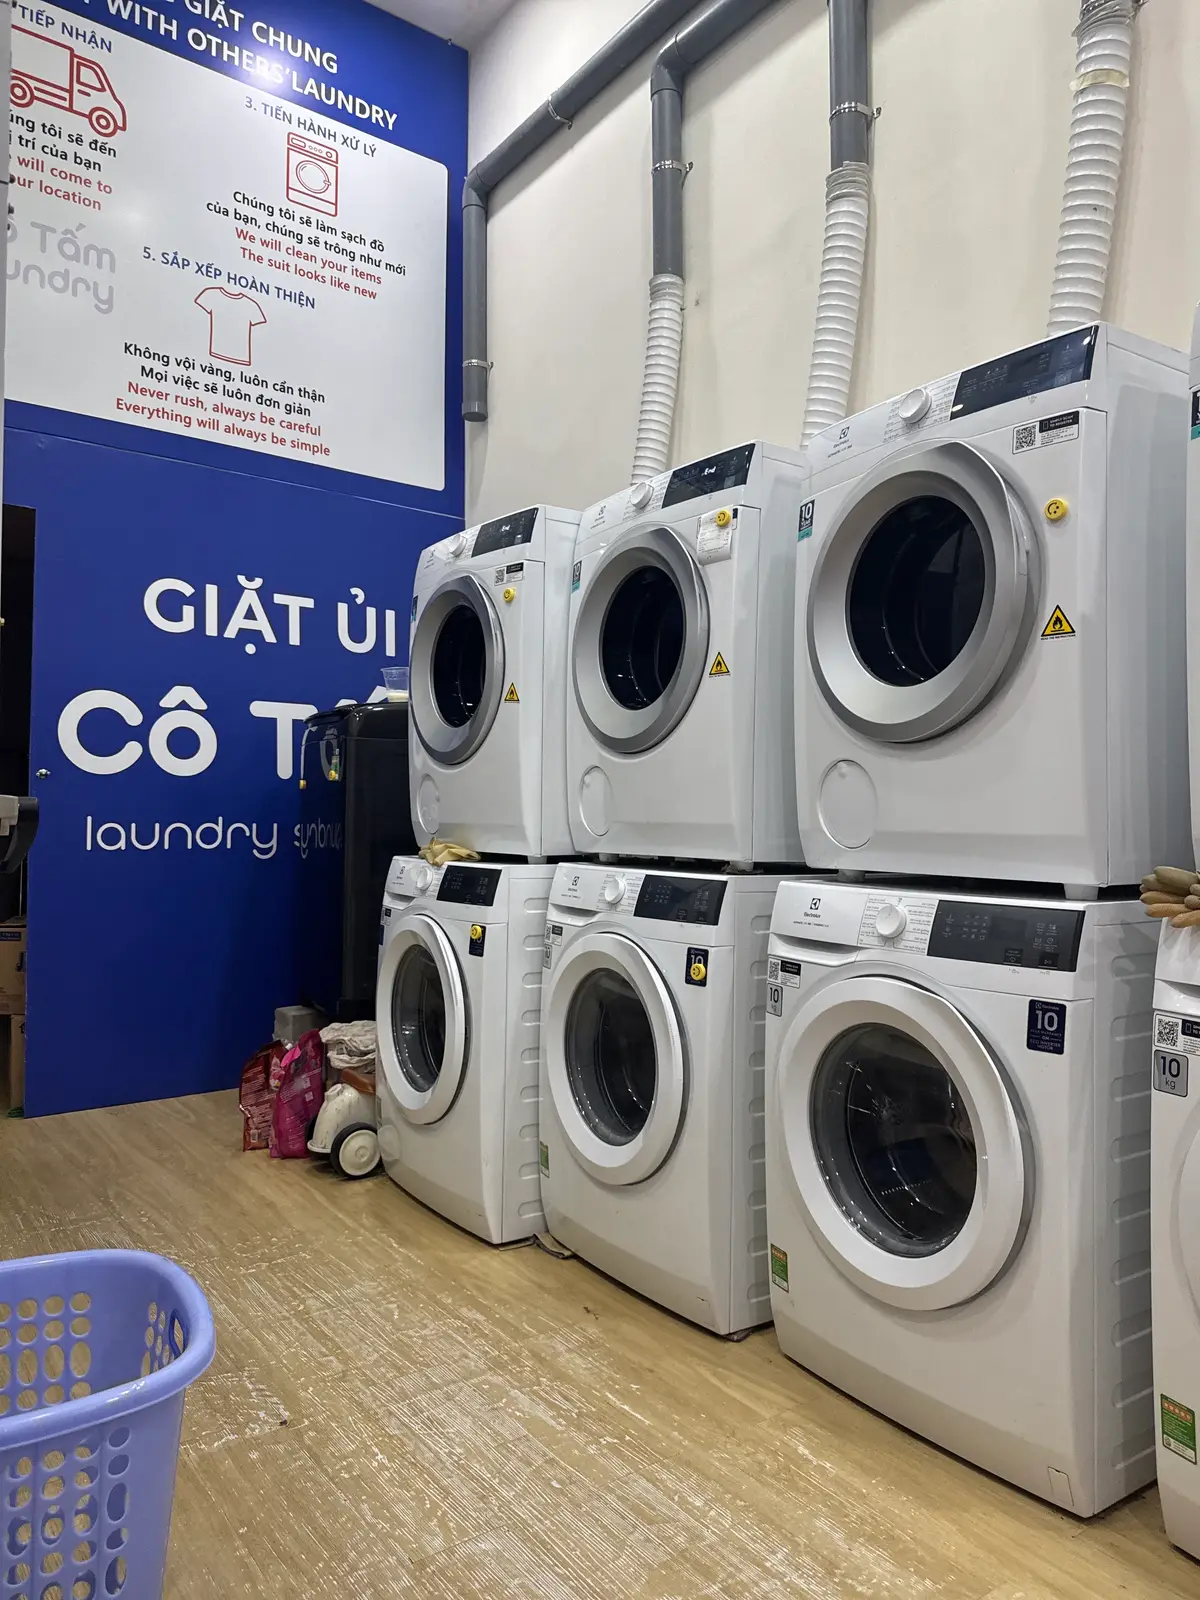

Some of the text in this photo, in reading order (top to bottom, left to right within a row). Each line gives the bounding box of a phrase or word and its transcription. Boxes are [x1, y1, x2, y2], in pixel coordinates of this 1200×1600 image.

[19, 5, 112, 53] TIẾP NHẬN
[107, 0, 177, 41] WITH
[252, 21, 338, 73] CHUNG
[18, 134, 36, 150] trí
[41, 144, 68, 161] của
[73, 151, 102, 172] bạn
[41, 122, 62, 139] tôi
[67, 133, 84, 146] sẽ
[89, 139, 117, 158] đến
[245, 96, 377, 158] 3. TIẾN HÀNH XỬ LÝ
[17, 155, 113, 194] will come to
[39, 180, 101, 211] location
[206, 201, 406, 276] của bạn, chúng sẽ trông như mới
[233, 191, 385, 252] Chúng tôi sẽ làm sạch đồ
[30, 222, 116, 274] Tấm
[235, 227, 382, 285] We will clean your items
[240, 247, 377, 300] The suit looks like new
[142, 246, 315, 309] 5. SẮP XẾP HOÀN THIỆN
[124, 341, 325, 403] Không vội vàng, luôn cẩn thận
[140, 365, 311, 417] Mọi việc sẽ luôn đơn giản
[116, 398, 330, 456] Everything will always be simple
[128, 381, 321, 437] Never rush, always be careful
[801, 503, 812, 521] 10
[143, 574, 396, 657] GIẶT ỦI
[57, 685, 218, 777] Cô
[86, 816, 278, 860] laundry
[770, 987, 779, 1003] 10
[1036, 1010, 1058, 1031] 10
[1161, 1056, 1180, 1078] 10
[1165, 1077, 1176, 1090] kg
